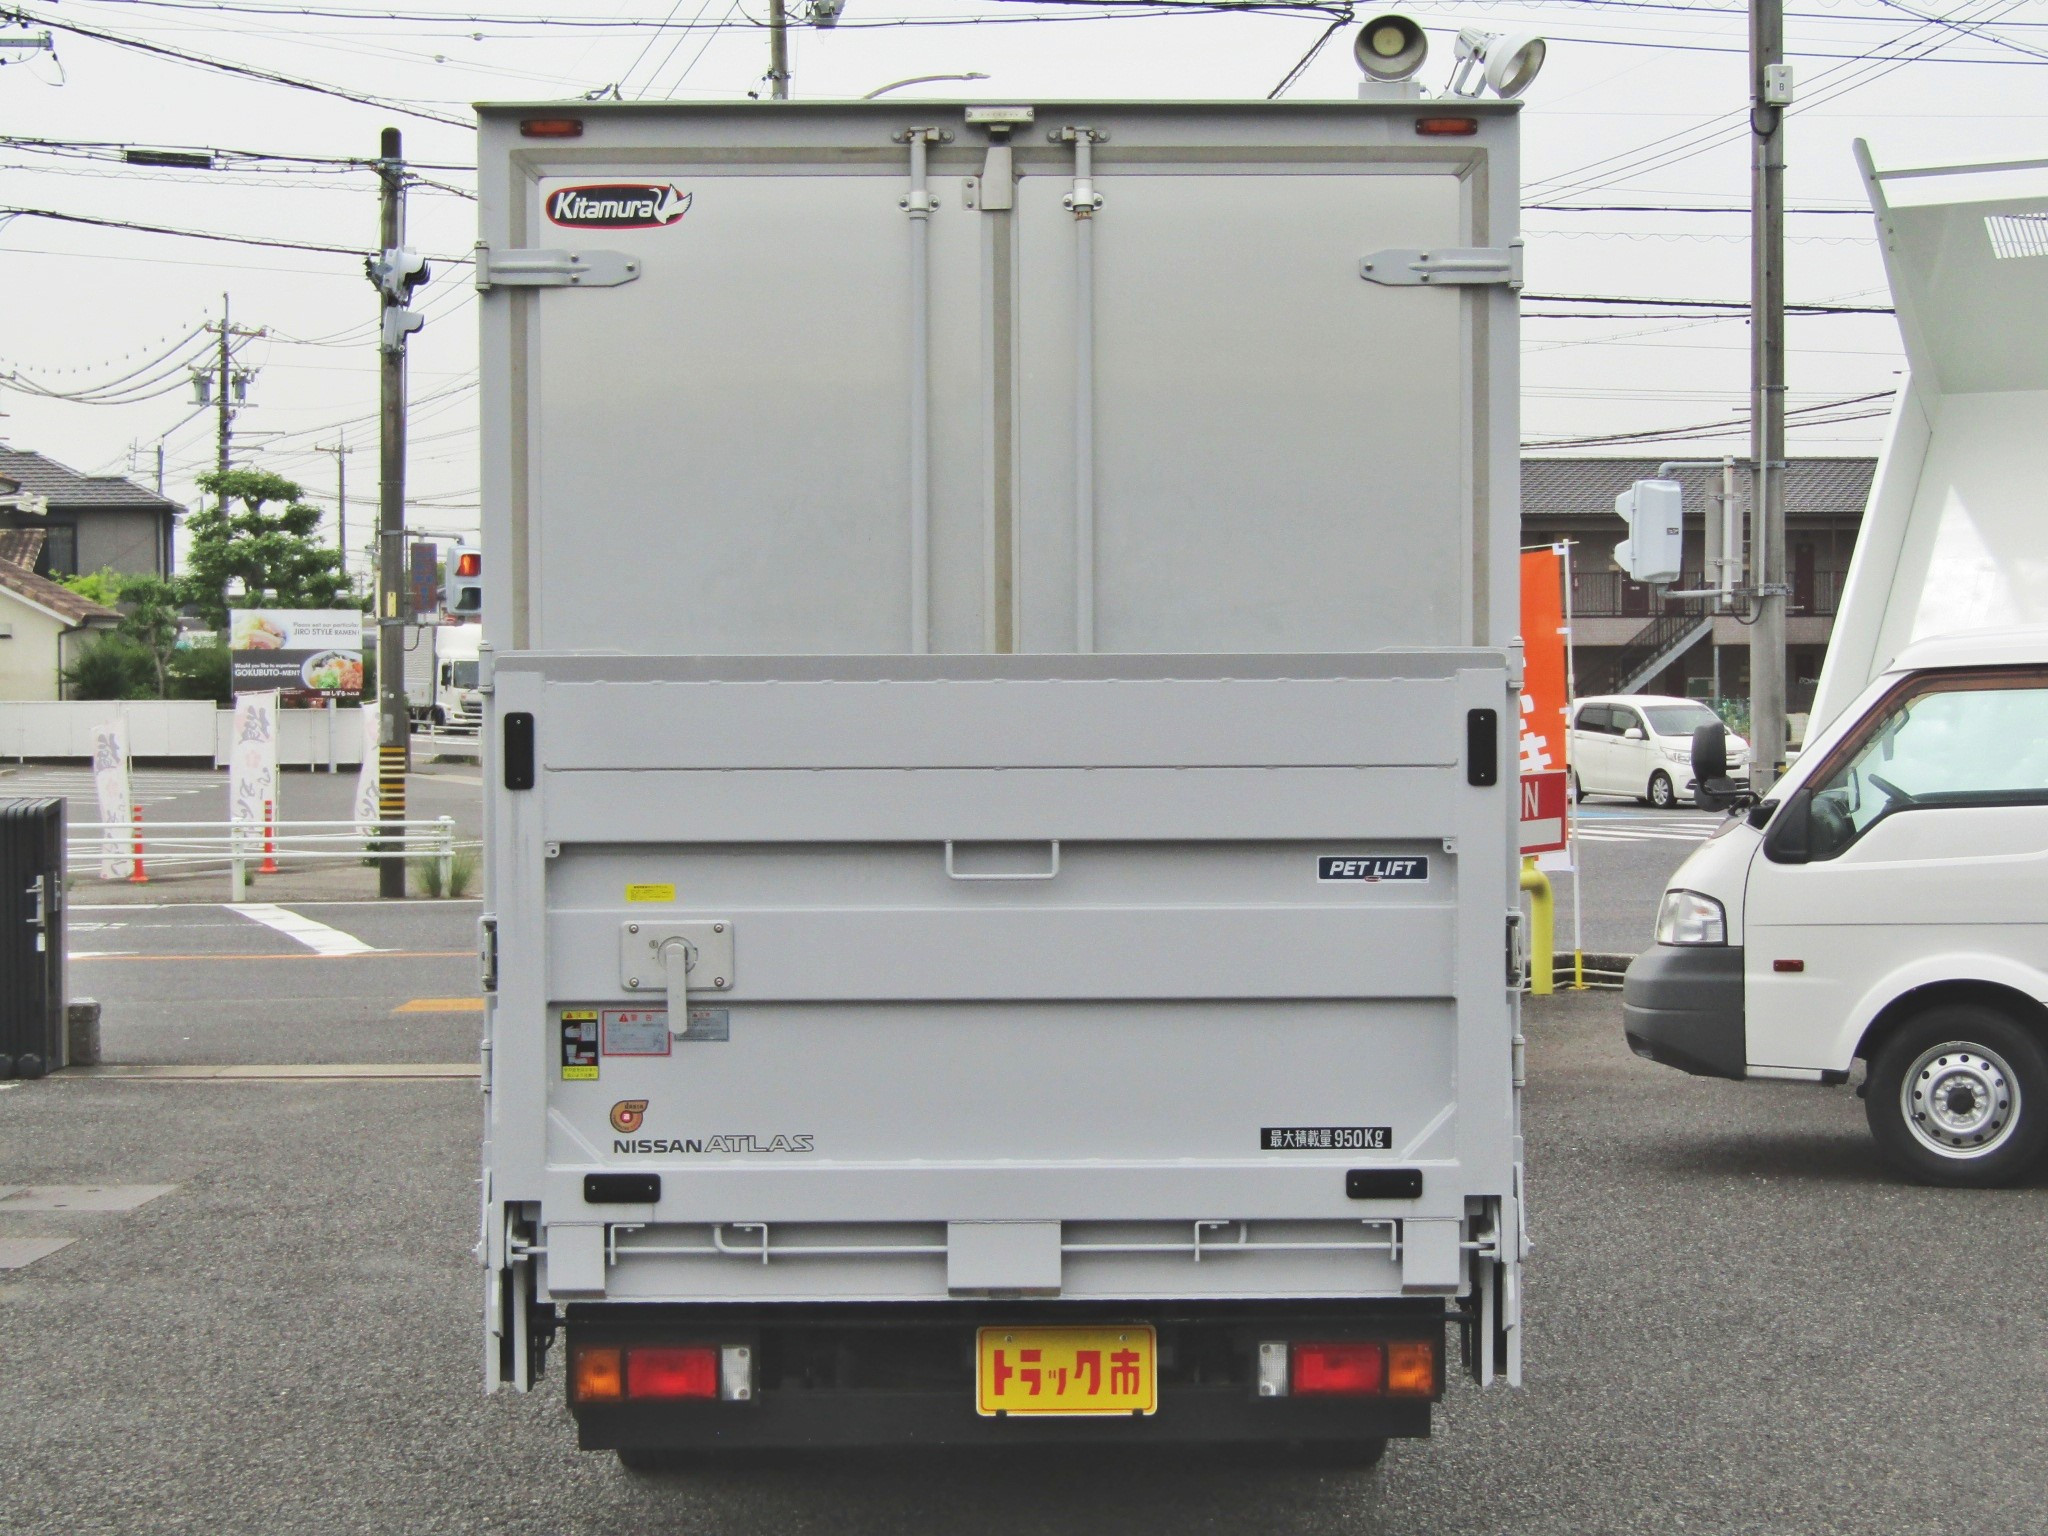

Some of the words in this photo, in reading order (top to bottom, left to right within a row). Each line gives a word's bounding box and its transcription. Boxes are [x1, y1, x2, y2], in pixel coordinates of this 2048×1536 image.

[554, 192, 654, 219] Kitamura
[1329, 861, 1371, 876] PET
[1373, 861, 1417, 876] LIFT
[613, 1139, 702, 1153] NISSAN
[704, 1135, 814, 1153] ATLAS
[993, 1348, 1141, 1396] トラック市
